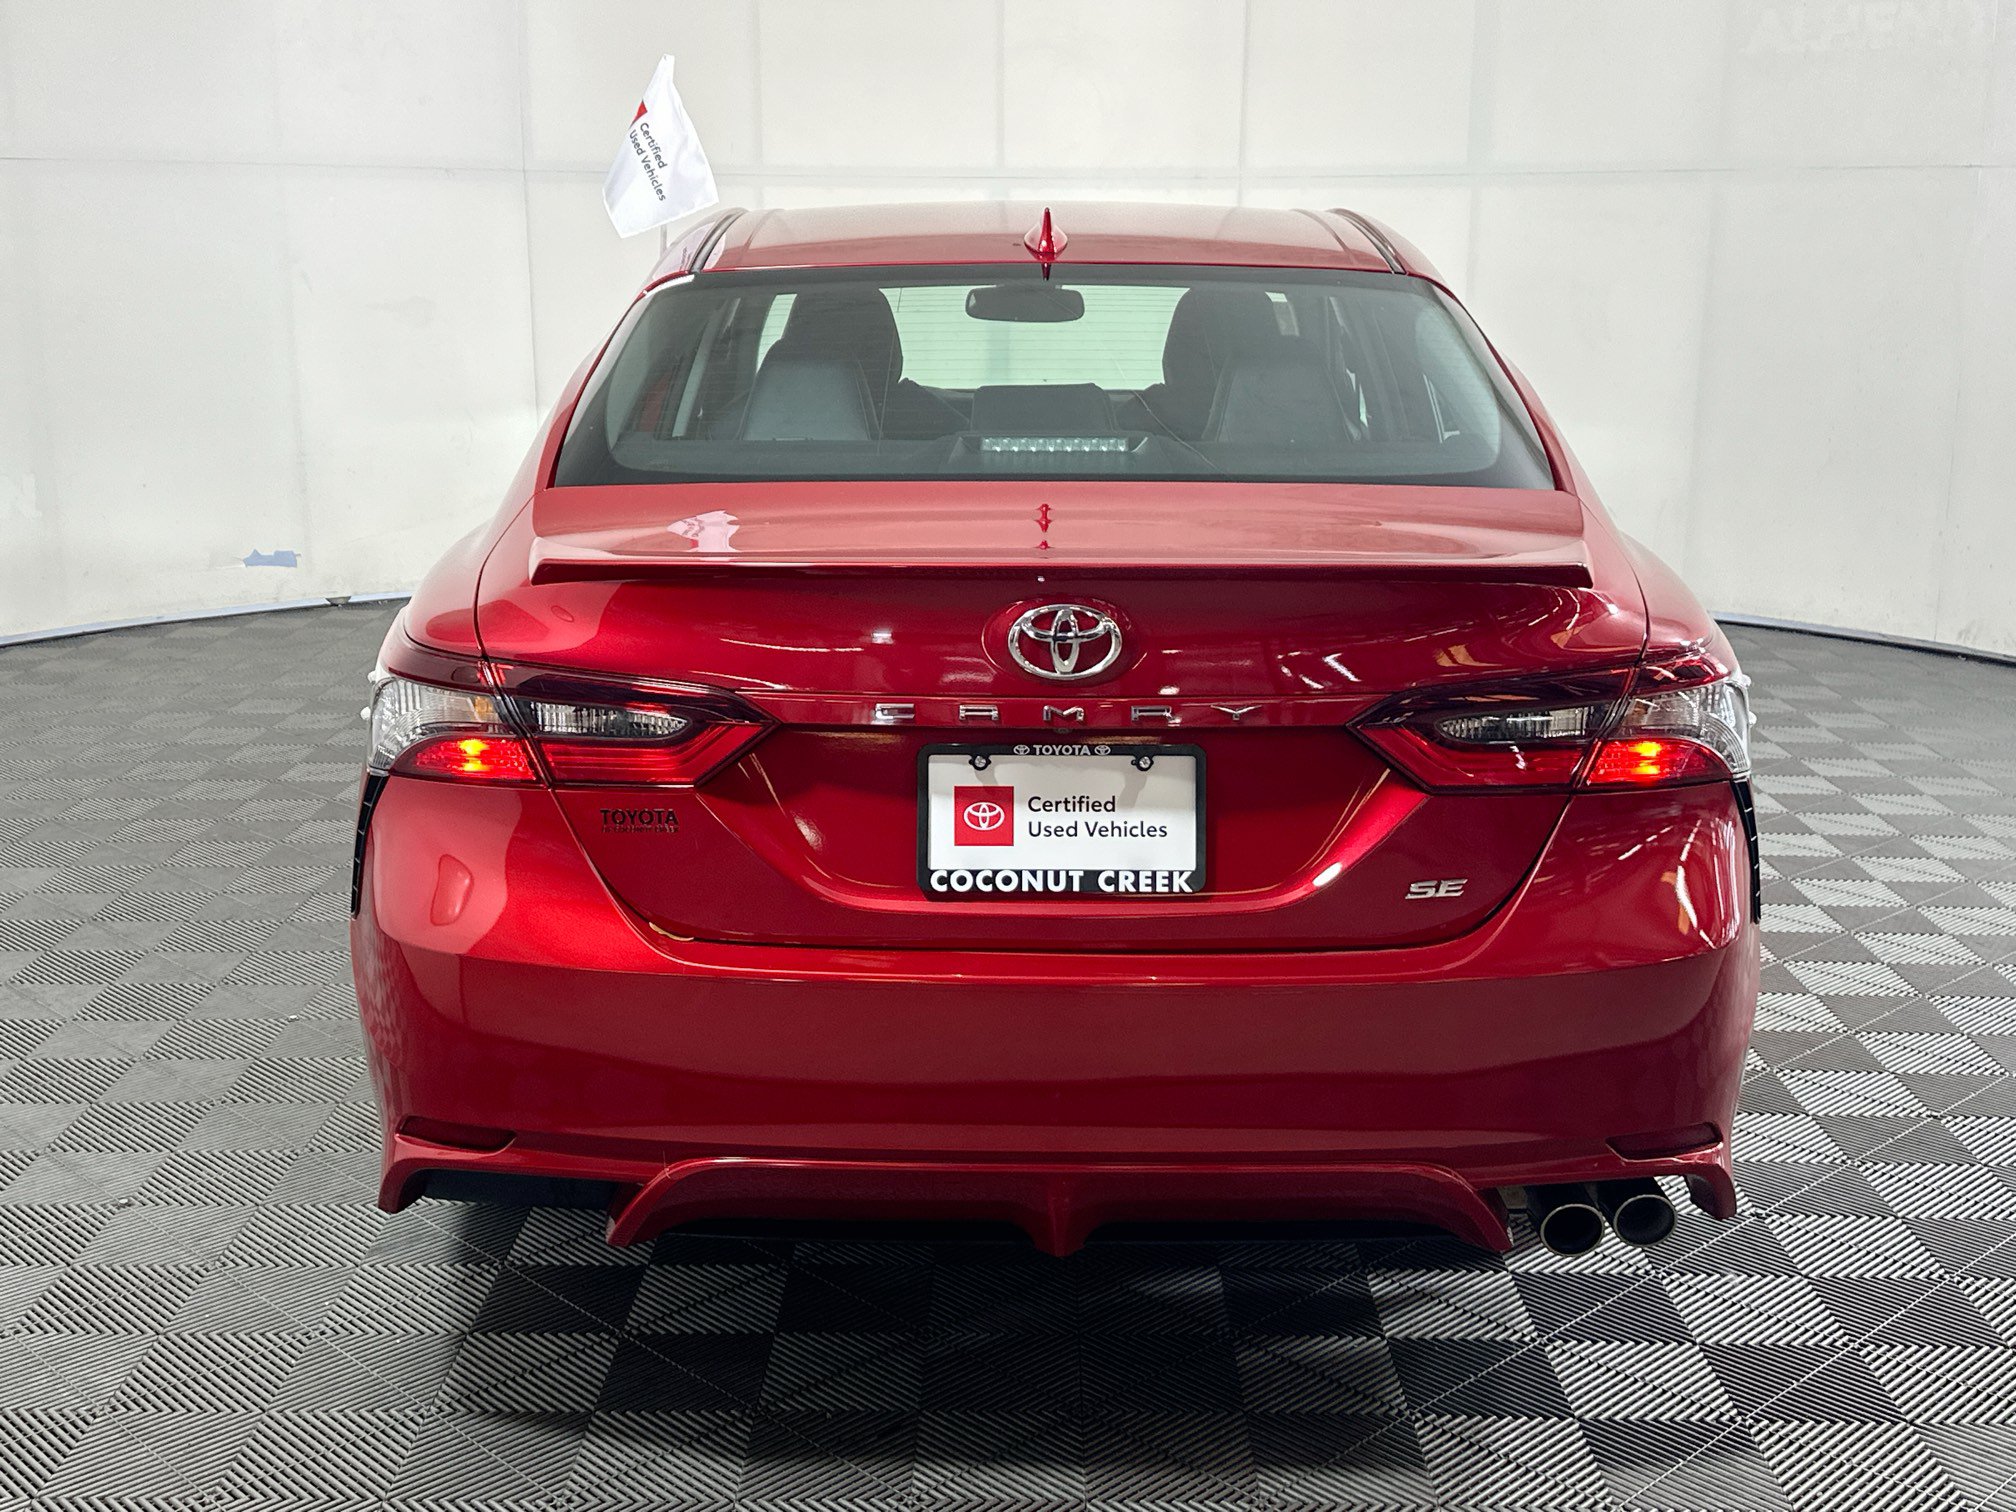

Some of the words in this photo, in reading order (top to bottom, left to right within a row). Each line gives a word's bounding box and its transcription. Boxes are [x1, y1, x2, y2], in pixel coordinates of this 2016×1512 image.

[639, 121, 668, 170] Certified
[629, 129, 647, 156] Used
[640, 154, 666, 201] Vehicles
[874, 702, 1263, 726] CAMRY
[1032, 744, 1092, 756] TOYOTA
[1027, 795, 1116, 813] Certified
[600, 808, 679, 825] TOYOTA
[1028, 820, 1078, 838] Used
[1085, 820, 1168, 838] Vehicles
[930, 869, 1085, 893] COCONUT
[1097, 869, 1193, 893] CREEK
[1405, 879, 1468, 900] SE
